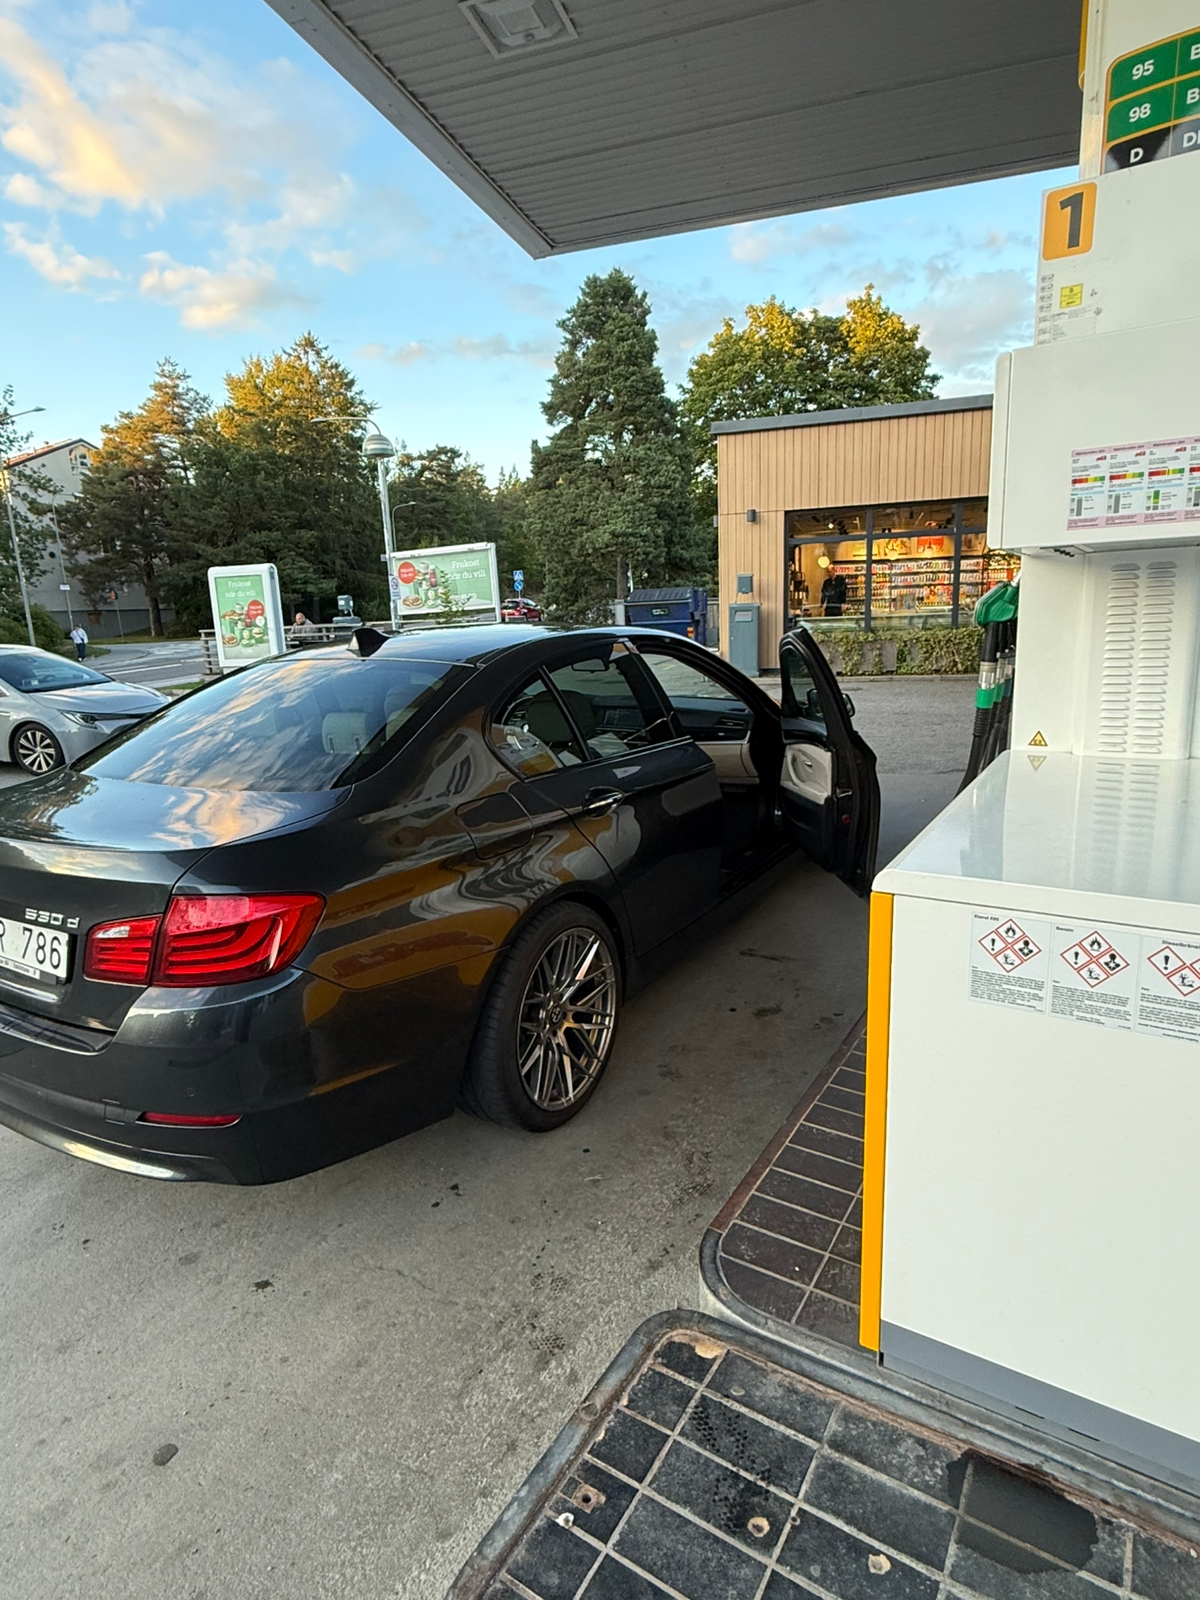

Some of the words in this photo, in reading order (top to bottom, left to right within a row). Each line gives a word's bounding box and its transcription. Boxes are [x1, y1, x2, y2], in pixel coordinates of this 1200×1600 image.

[1131, 59, 1155, 80] 95
[1129, 103, 1152, 123] 98
[1129, 147, 1144, 164] D
[1059, 191, 1084, 249] 1
[451, 559, 480, 569] Frukost
[462, 571, 473, 579] du
[473, 569, 486, 578] vill
[227, 580, 252, 588] Frukost
[245, 589, 257, 597] vill
[22, 926, 62, 970] 786
